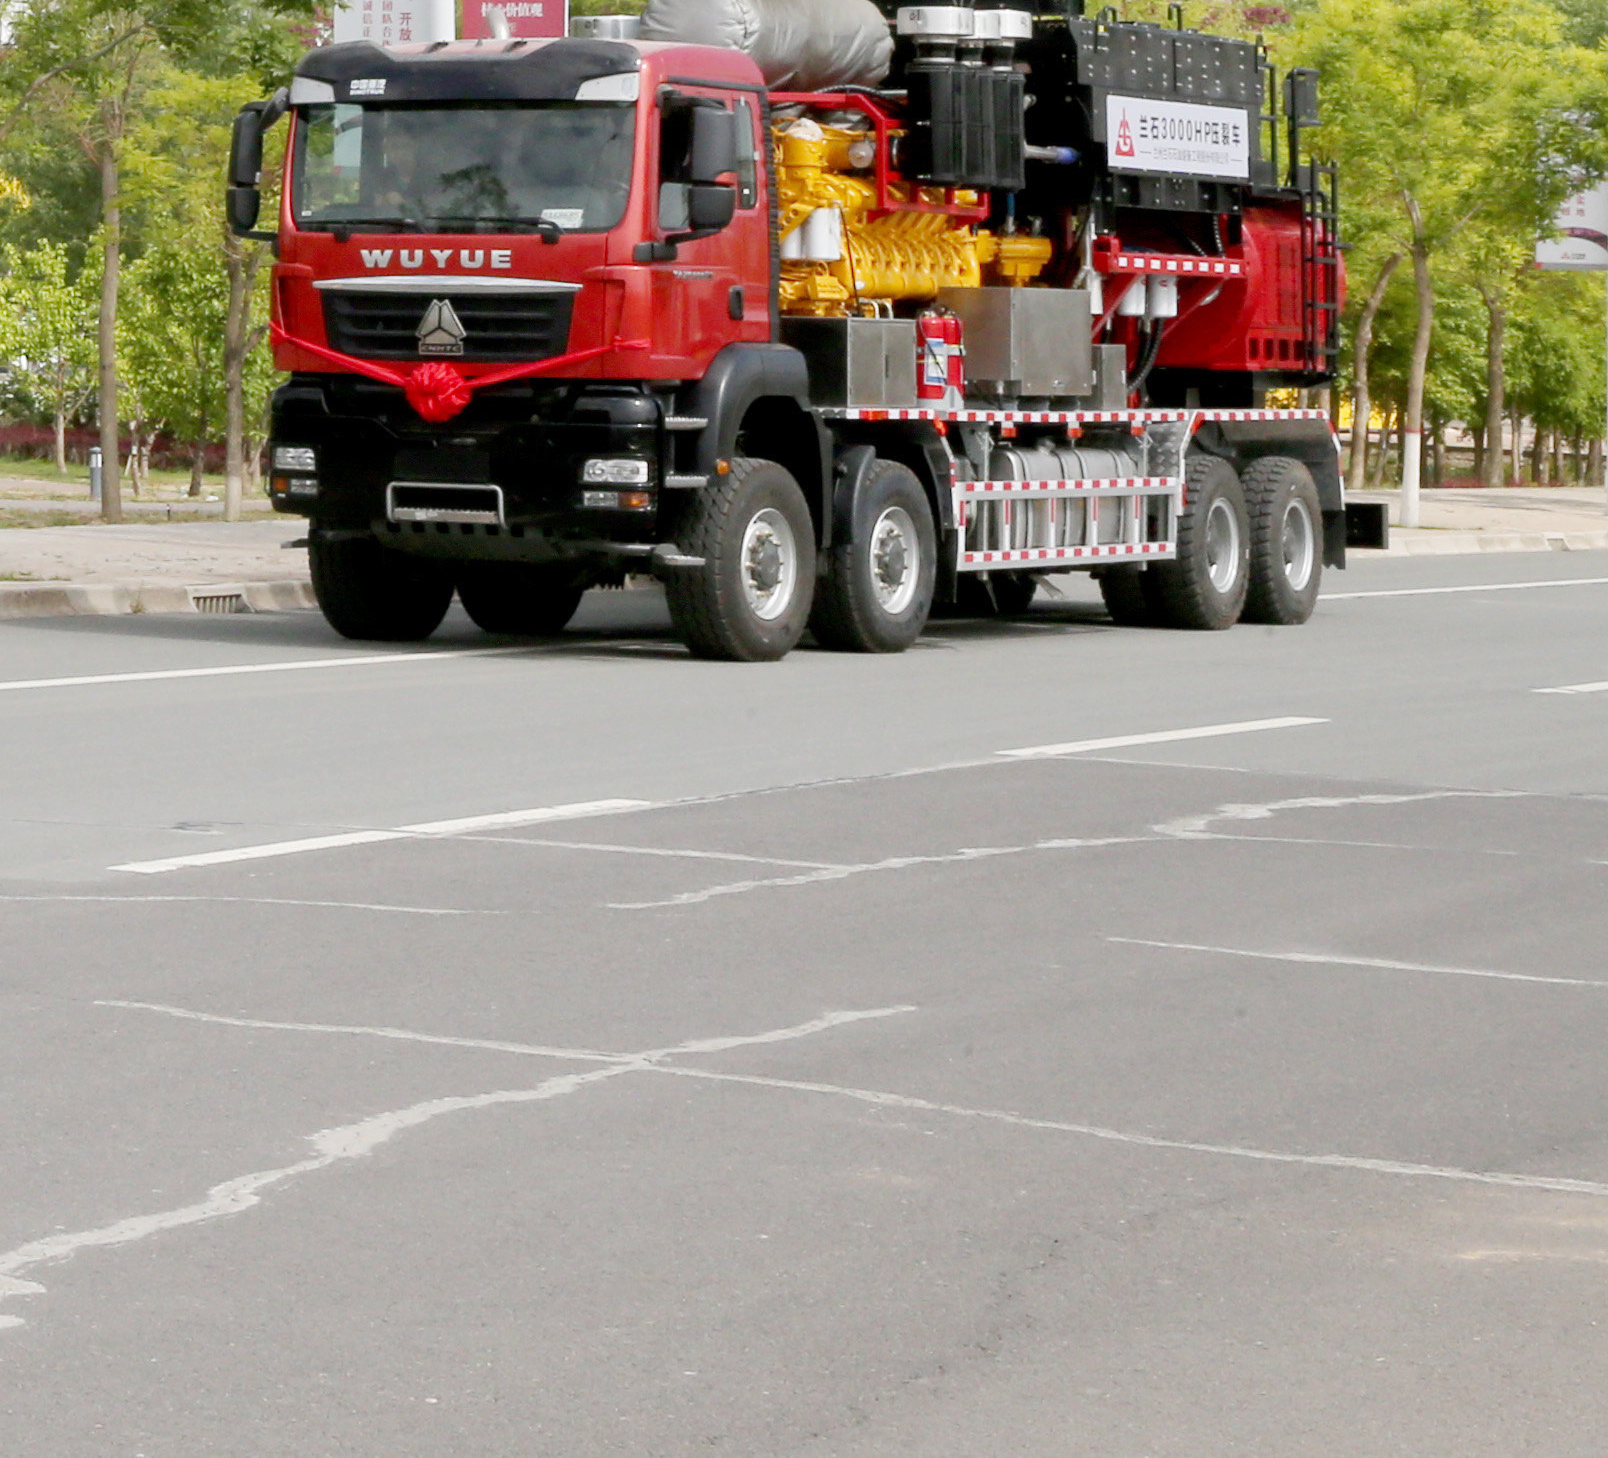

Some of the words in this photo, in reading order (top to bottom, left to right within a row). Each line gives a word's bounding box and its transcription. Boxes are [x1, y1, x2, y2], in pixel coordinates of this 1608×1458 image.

[1139, 114, 1240, 148] 兰石3000HP压裂车
[360, 249, 513, 269] WUYUE
